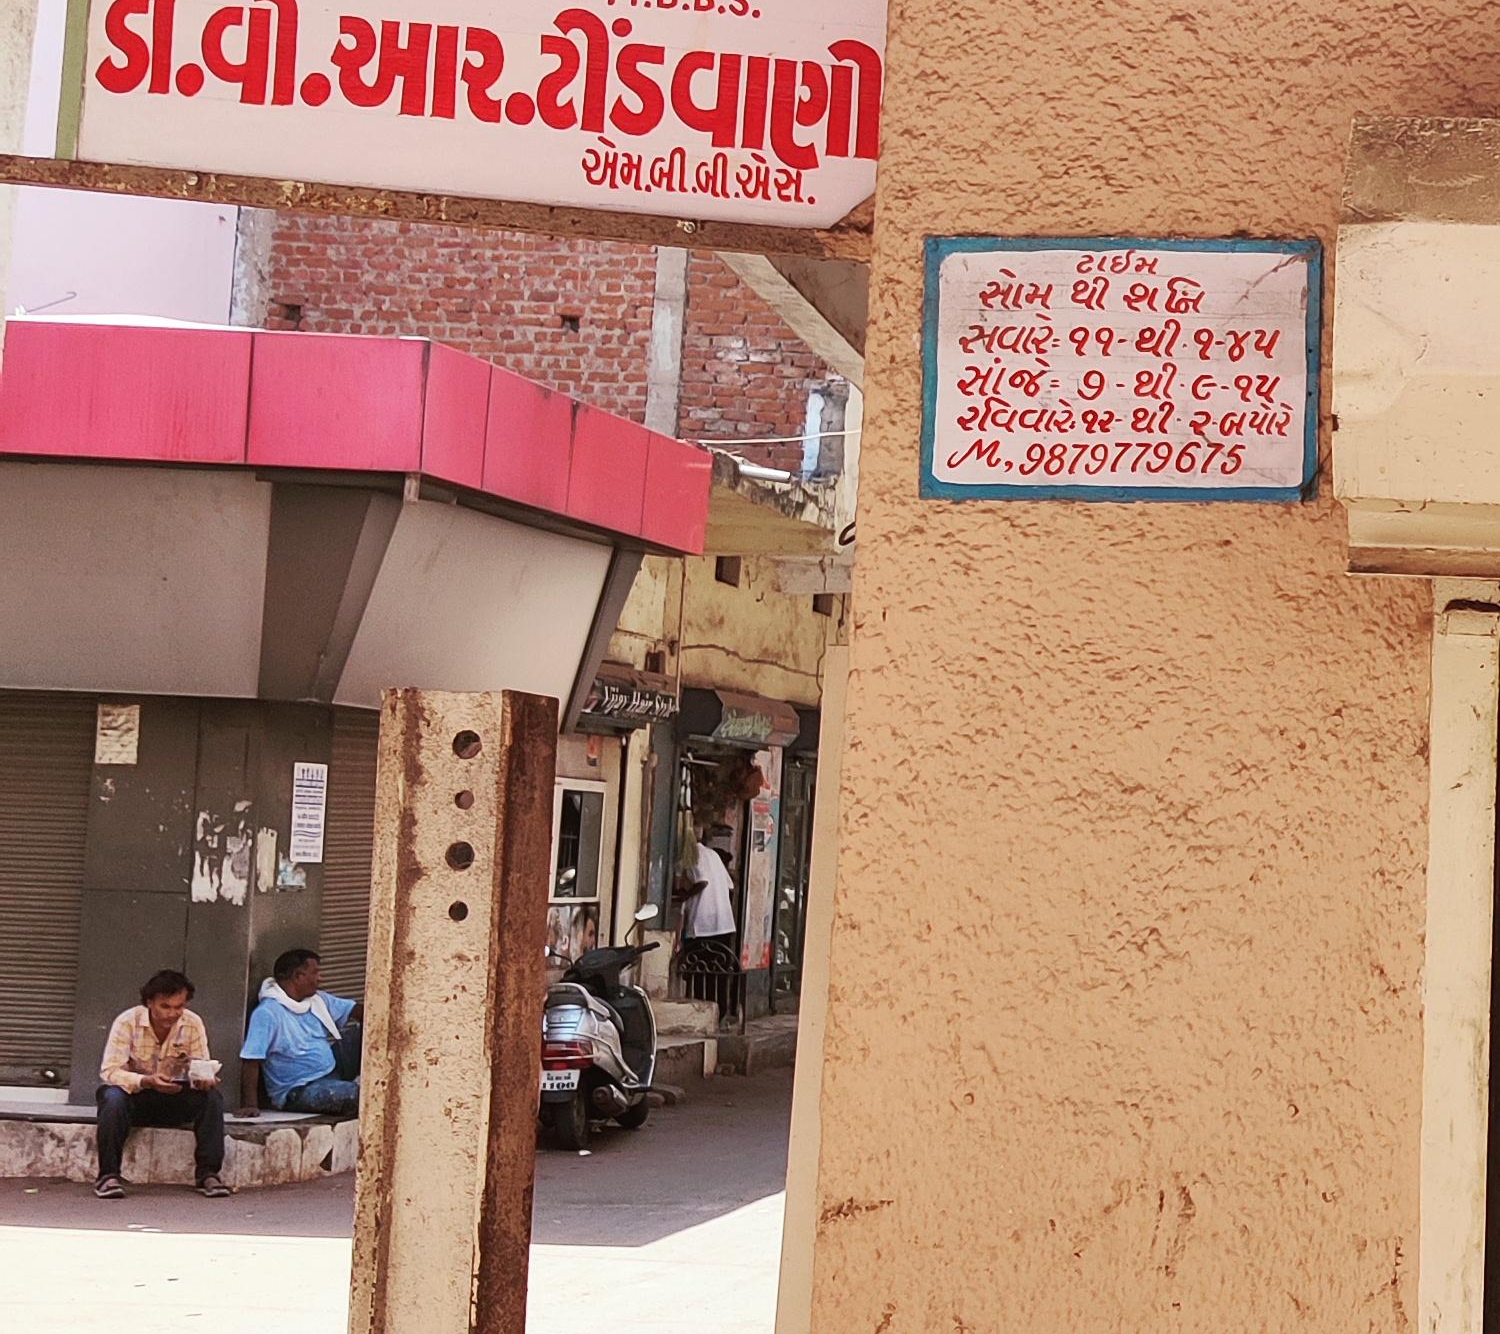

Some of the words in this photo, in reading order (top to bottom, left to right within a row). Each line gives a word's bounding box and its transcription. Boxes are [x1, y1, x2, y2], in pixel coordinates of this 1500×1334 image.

[1075, 250, 1160, 277] ટાઈમ
[977, 268, 1054, 311] સોમ
[1071, 275, 1112, 311] થી
[1122, 276, 1206, 315] શનિ
